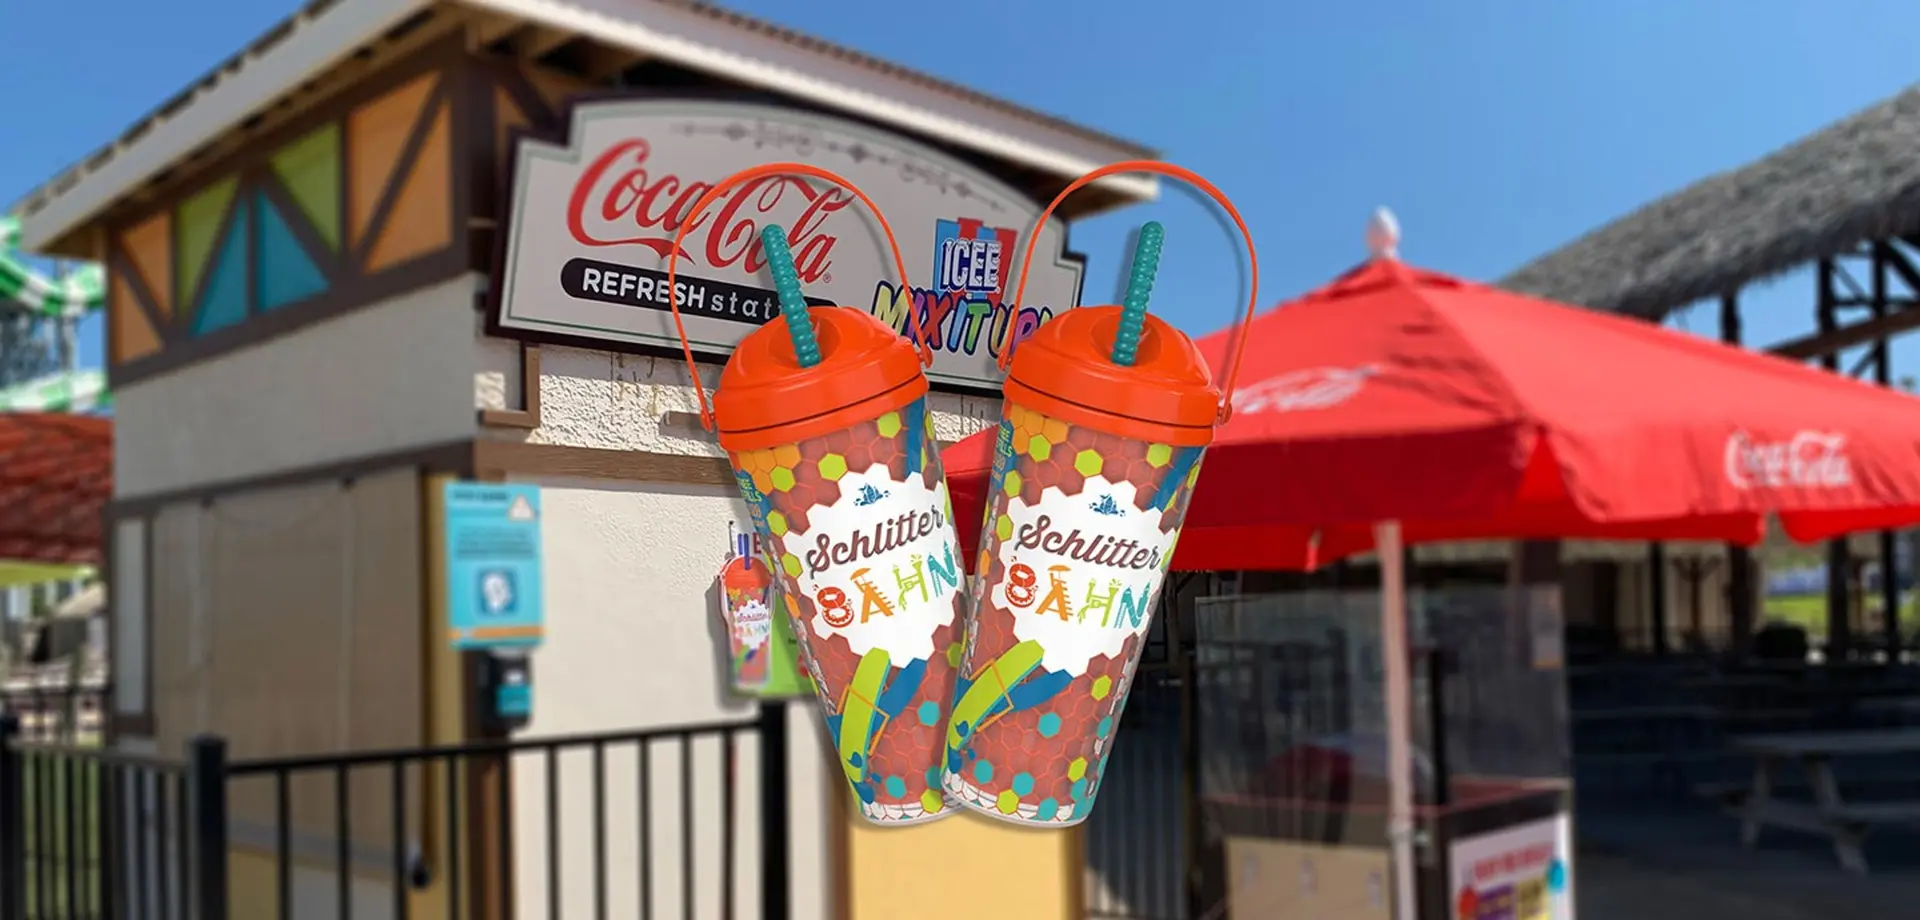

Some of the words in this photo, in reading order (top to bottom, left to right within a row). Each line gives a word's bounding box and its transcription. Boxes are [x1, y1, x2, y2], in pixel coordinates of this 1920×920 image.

[941, 238, 1002, 291] ICEE
[582, 267, 705, 309] REFRESH
[710, 291, 783, 320] stat
[871, 281, 952, 351] MIX
[946, 298, 991, 354] IT
[807, 505, 944, 580] Schlitter
[1014, 514, 1161, 571] Schlitter
